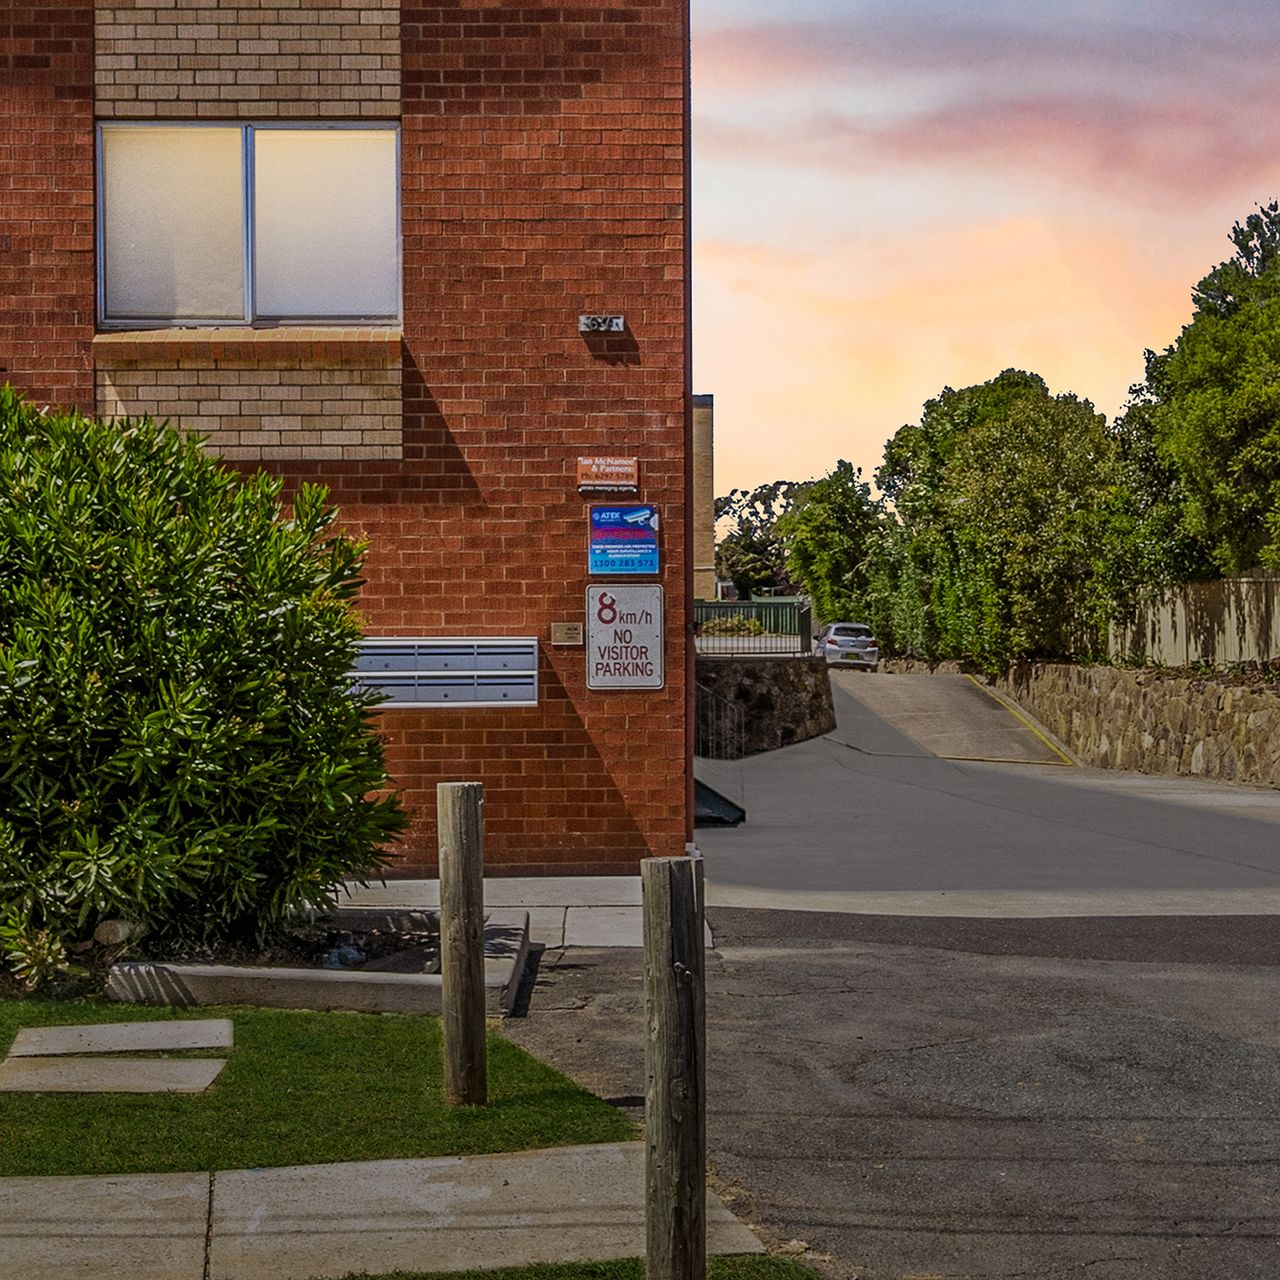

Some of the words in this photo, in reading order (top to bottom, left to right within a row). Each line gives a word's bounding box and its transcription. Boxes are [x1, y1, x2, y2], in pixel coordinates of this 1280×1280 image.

[597, 592, 617, 625] 8
[619, 609, 653, 625] km/h
[613, 629, 633, 644] NO
[597, 645, 648, 661] VISITOR
[595, 662, 654, 677] PARKING
